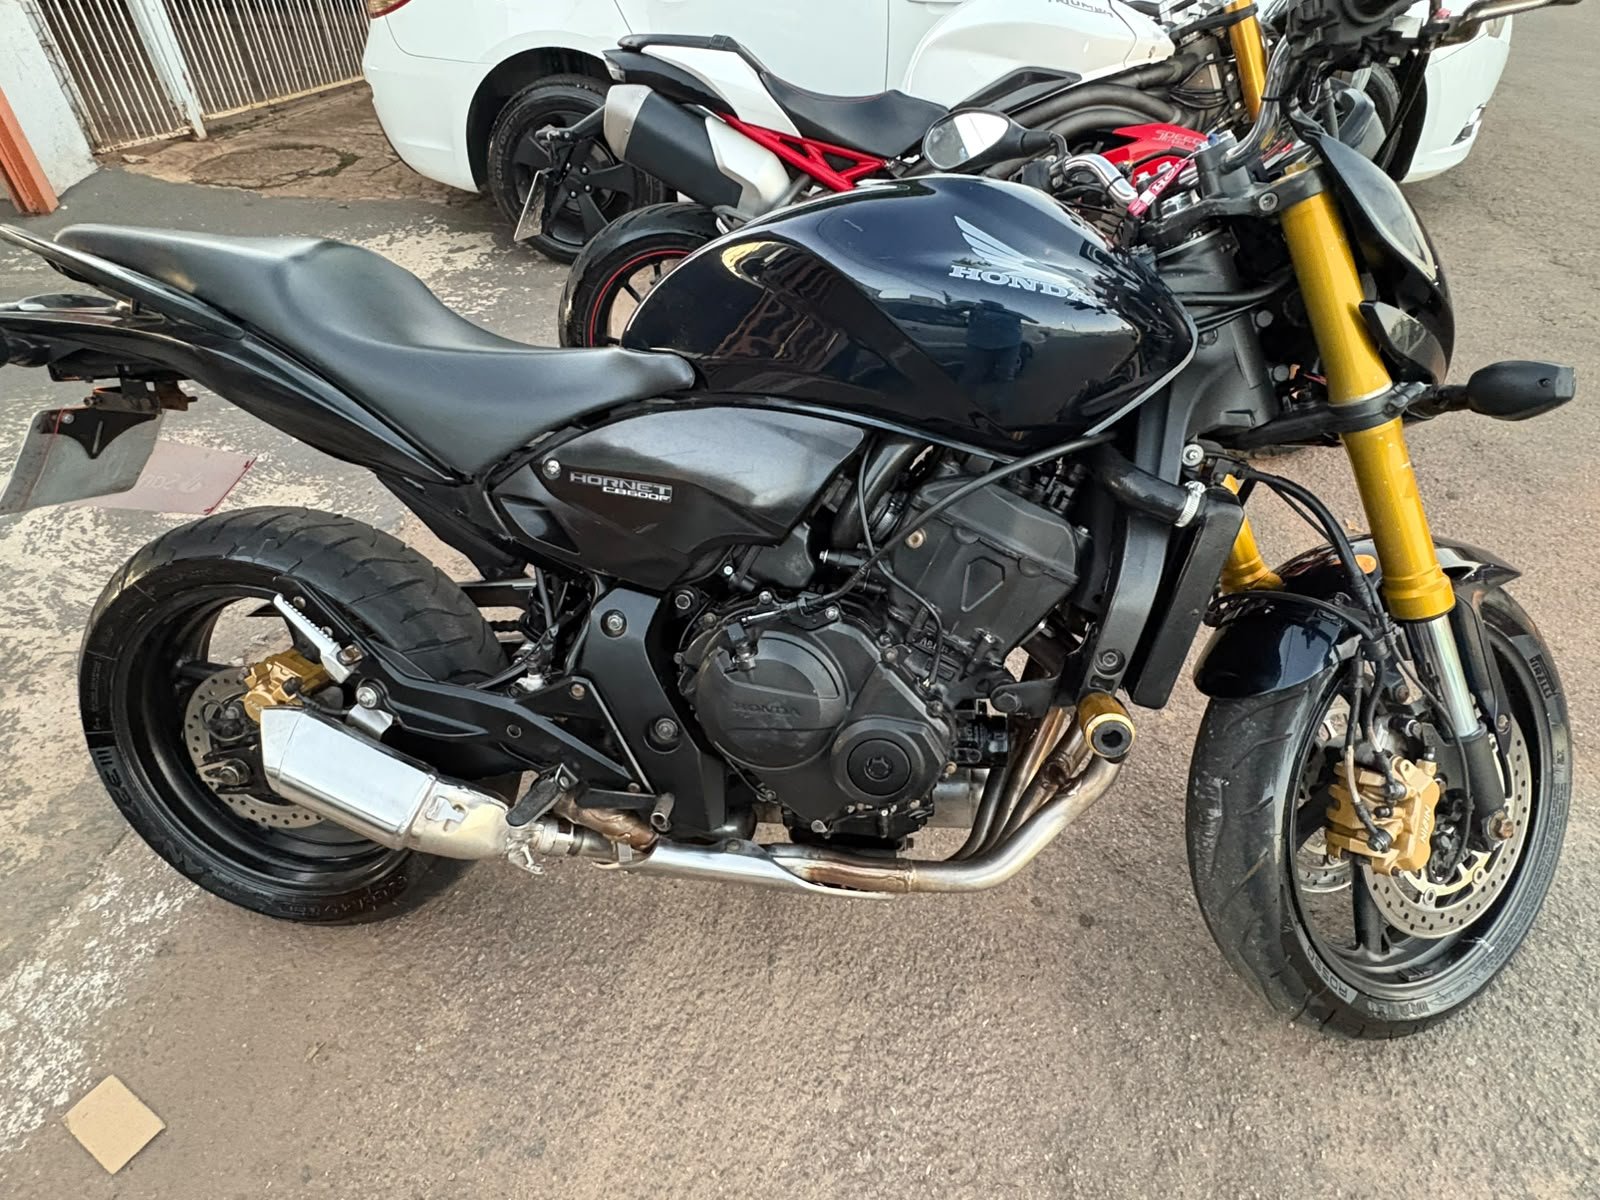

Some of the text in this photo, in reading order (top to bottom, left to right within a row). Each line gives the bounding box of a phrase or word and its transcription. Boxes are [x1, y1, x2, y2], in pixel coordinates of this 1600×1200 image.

[948, 264, 1106, 307] HONDA
[569, 472, 673, 495] HORNET
[602, 486, 672, 503] CB600F
[1306, 946, 1350, 998] ROSSO
